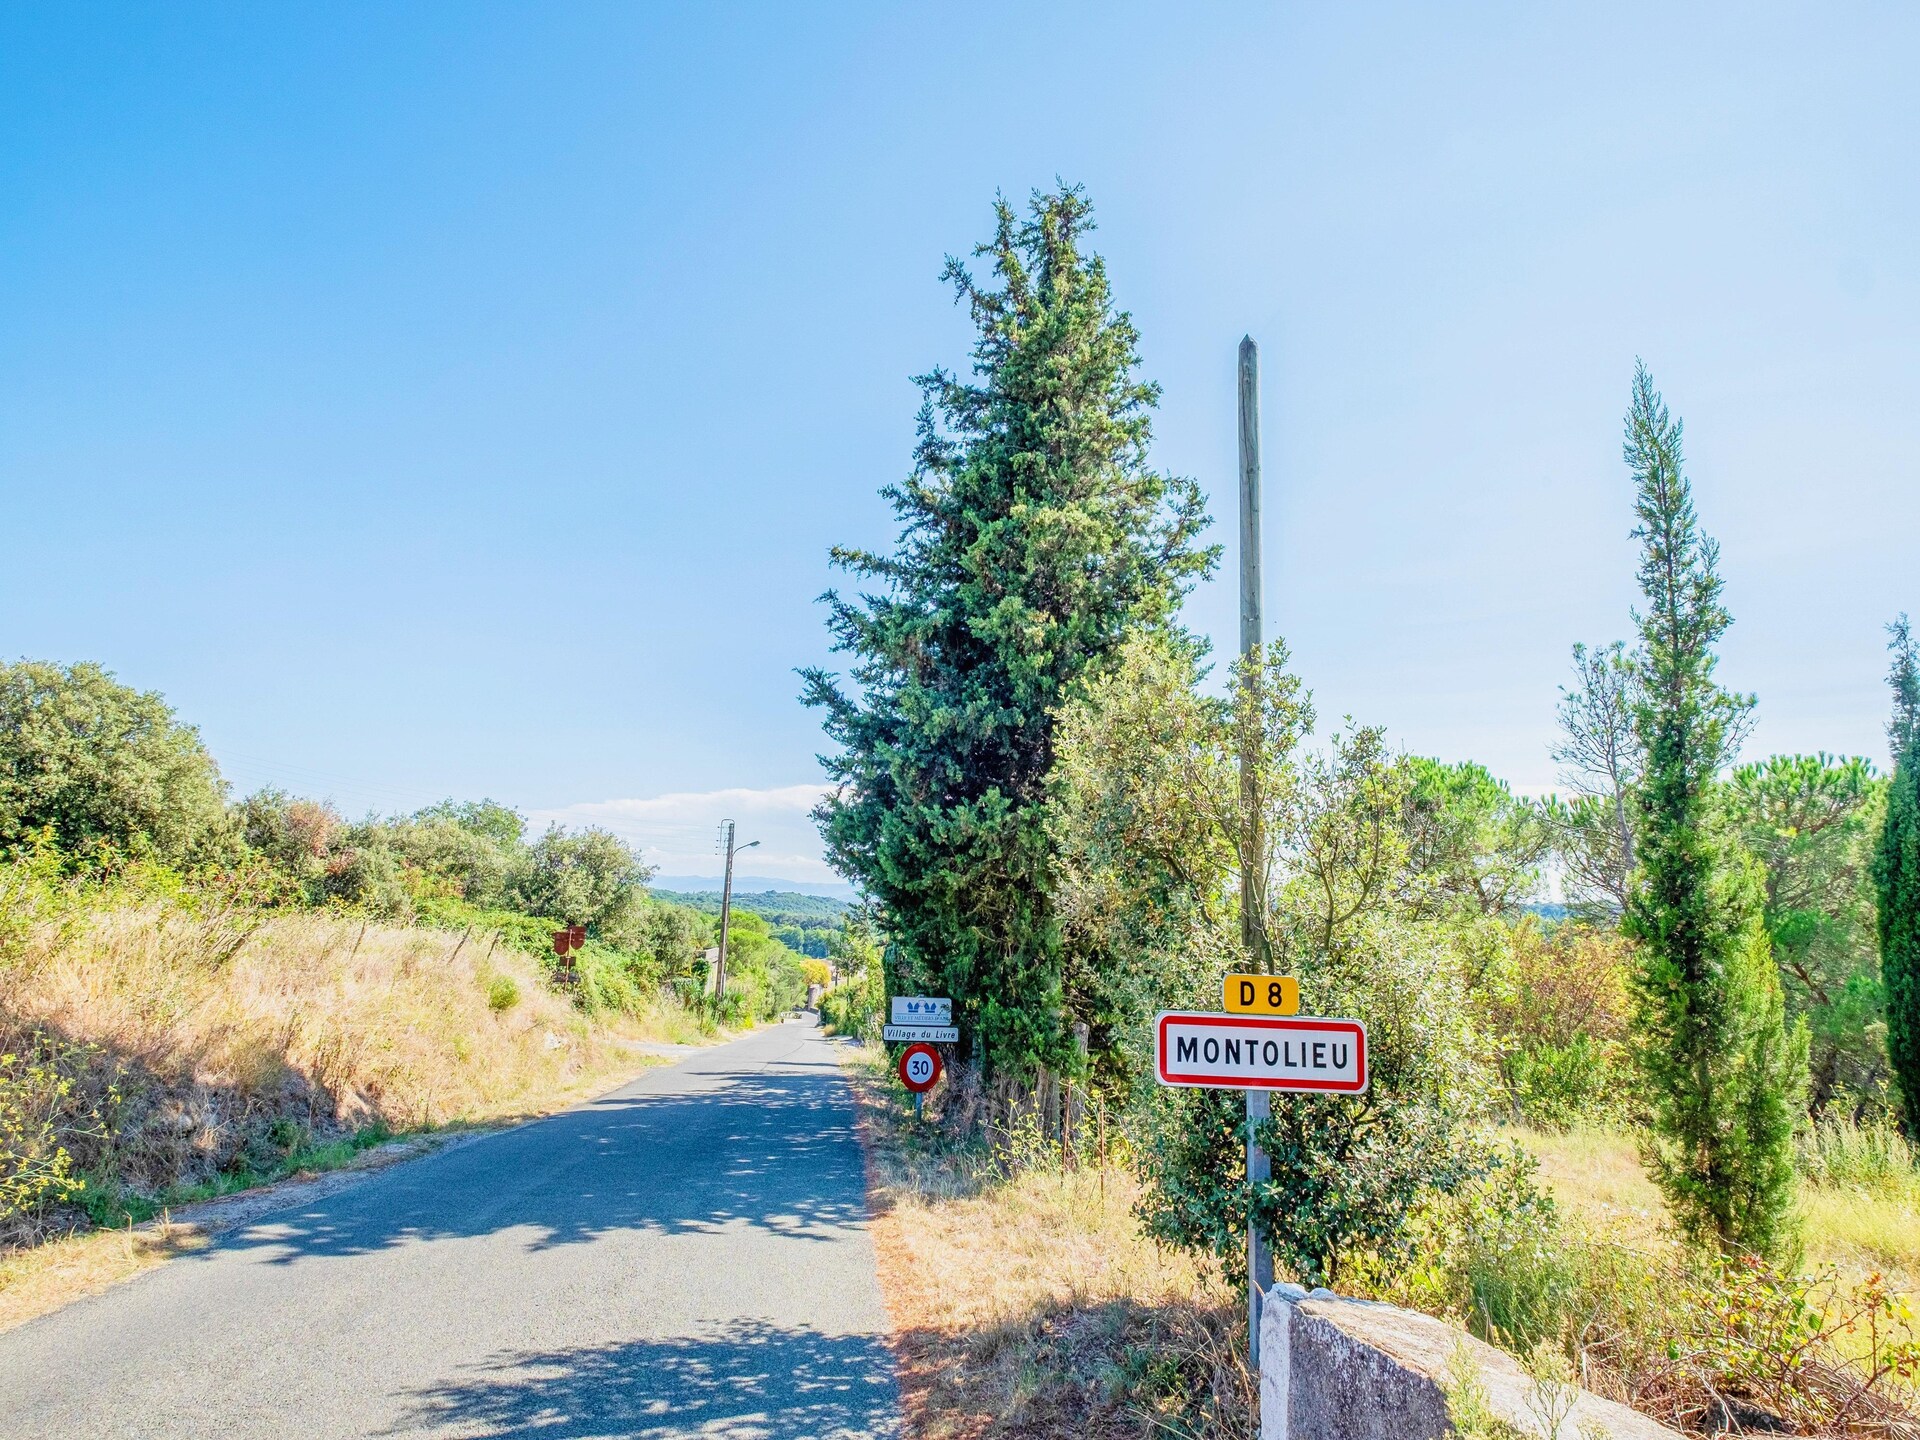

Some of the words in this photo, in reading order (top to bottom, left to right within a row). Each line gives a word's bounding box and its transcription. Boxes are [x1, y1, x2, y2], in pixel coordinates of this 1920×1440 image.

[1240, 981, 1255, 1006] D
[1267, 982, 1283, 1007] 8
[887, 1029, 916, 1040] Village
[921, 1030, 931, 1038] du
[935, 1030, 956, 1039] Livre
[1176, 1036, 1348, 1069] MONTOLIEU
[911, 1060, 929, 1076] 30
